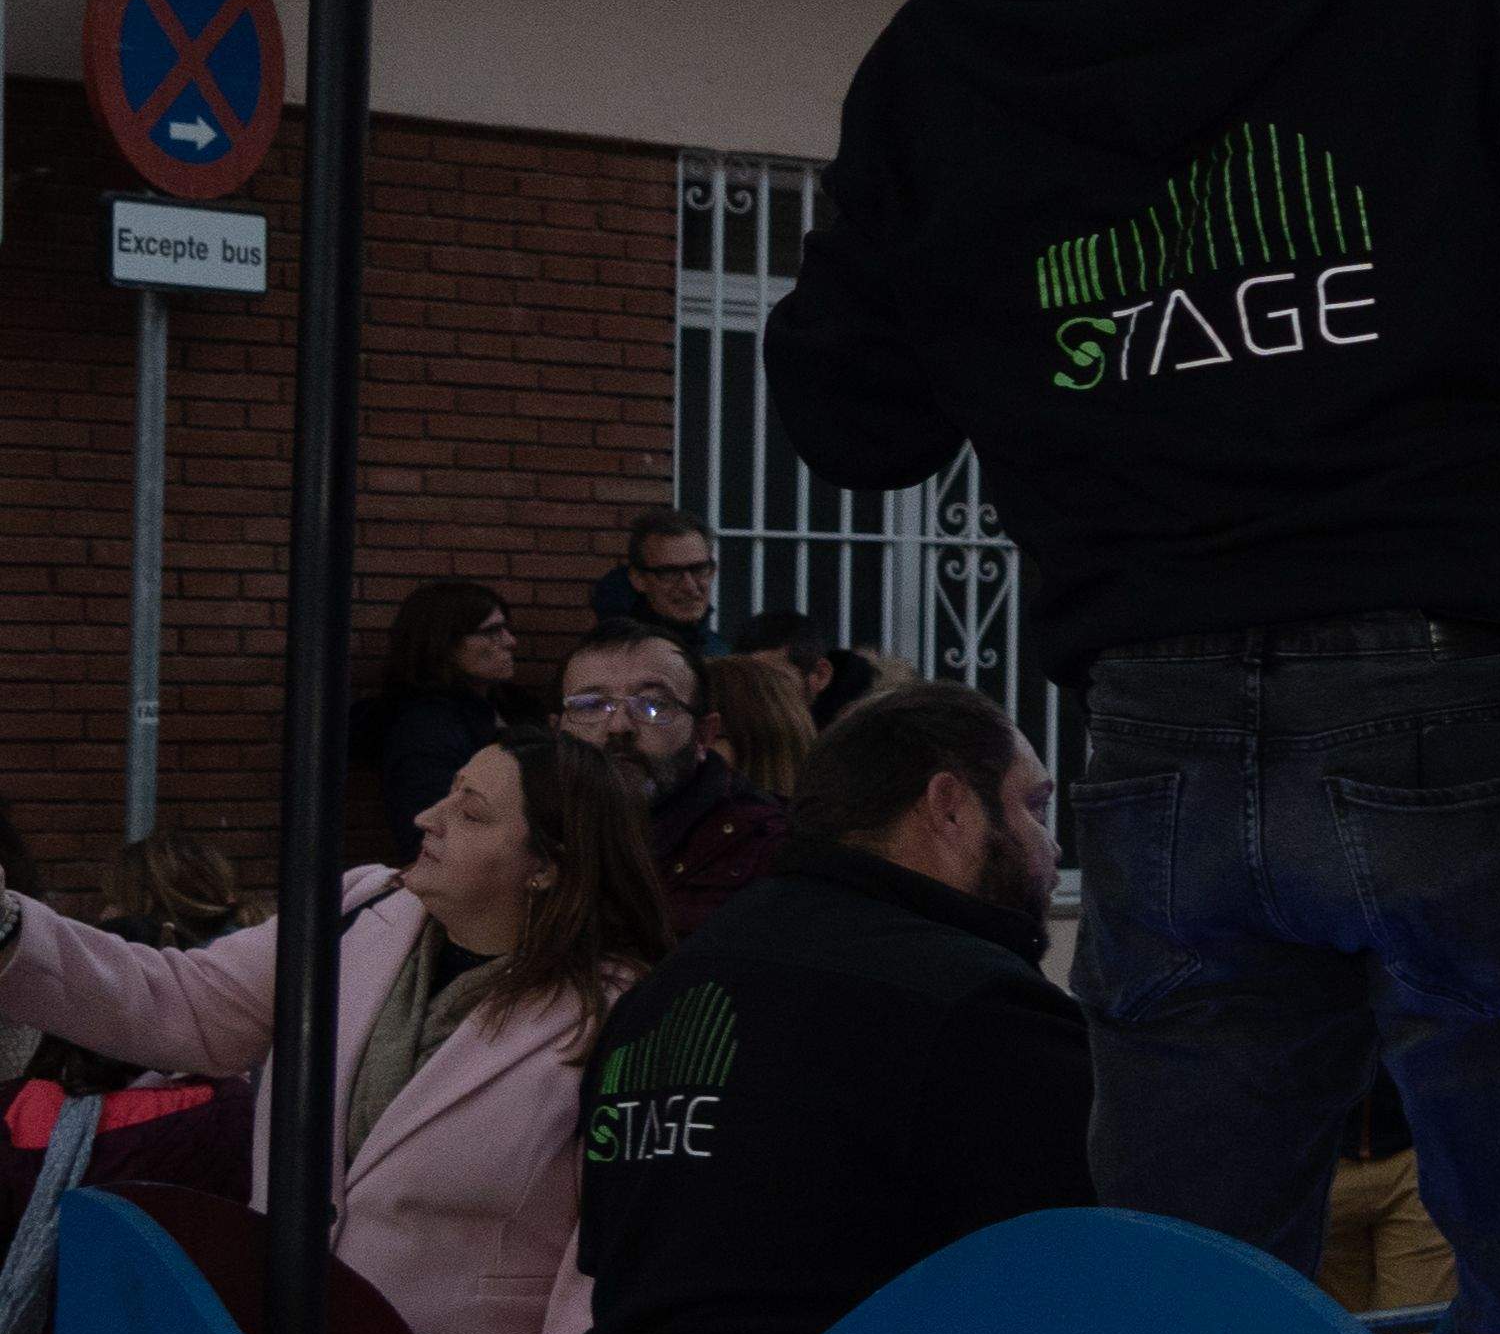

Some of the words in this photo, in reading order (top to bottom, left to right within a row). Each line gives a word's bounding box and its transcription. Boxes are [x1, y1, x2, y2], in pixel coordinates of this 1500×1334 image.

[116, 227, 209, 264] Excepte
[221, 232, 262, 267] bus
[1053, 262, 1379, 391] STAGE
[585, 1094, 721, 1163] STAGE
